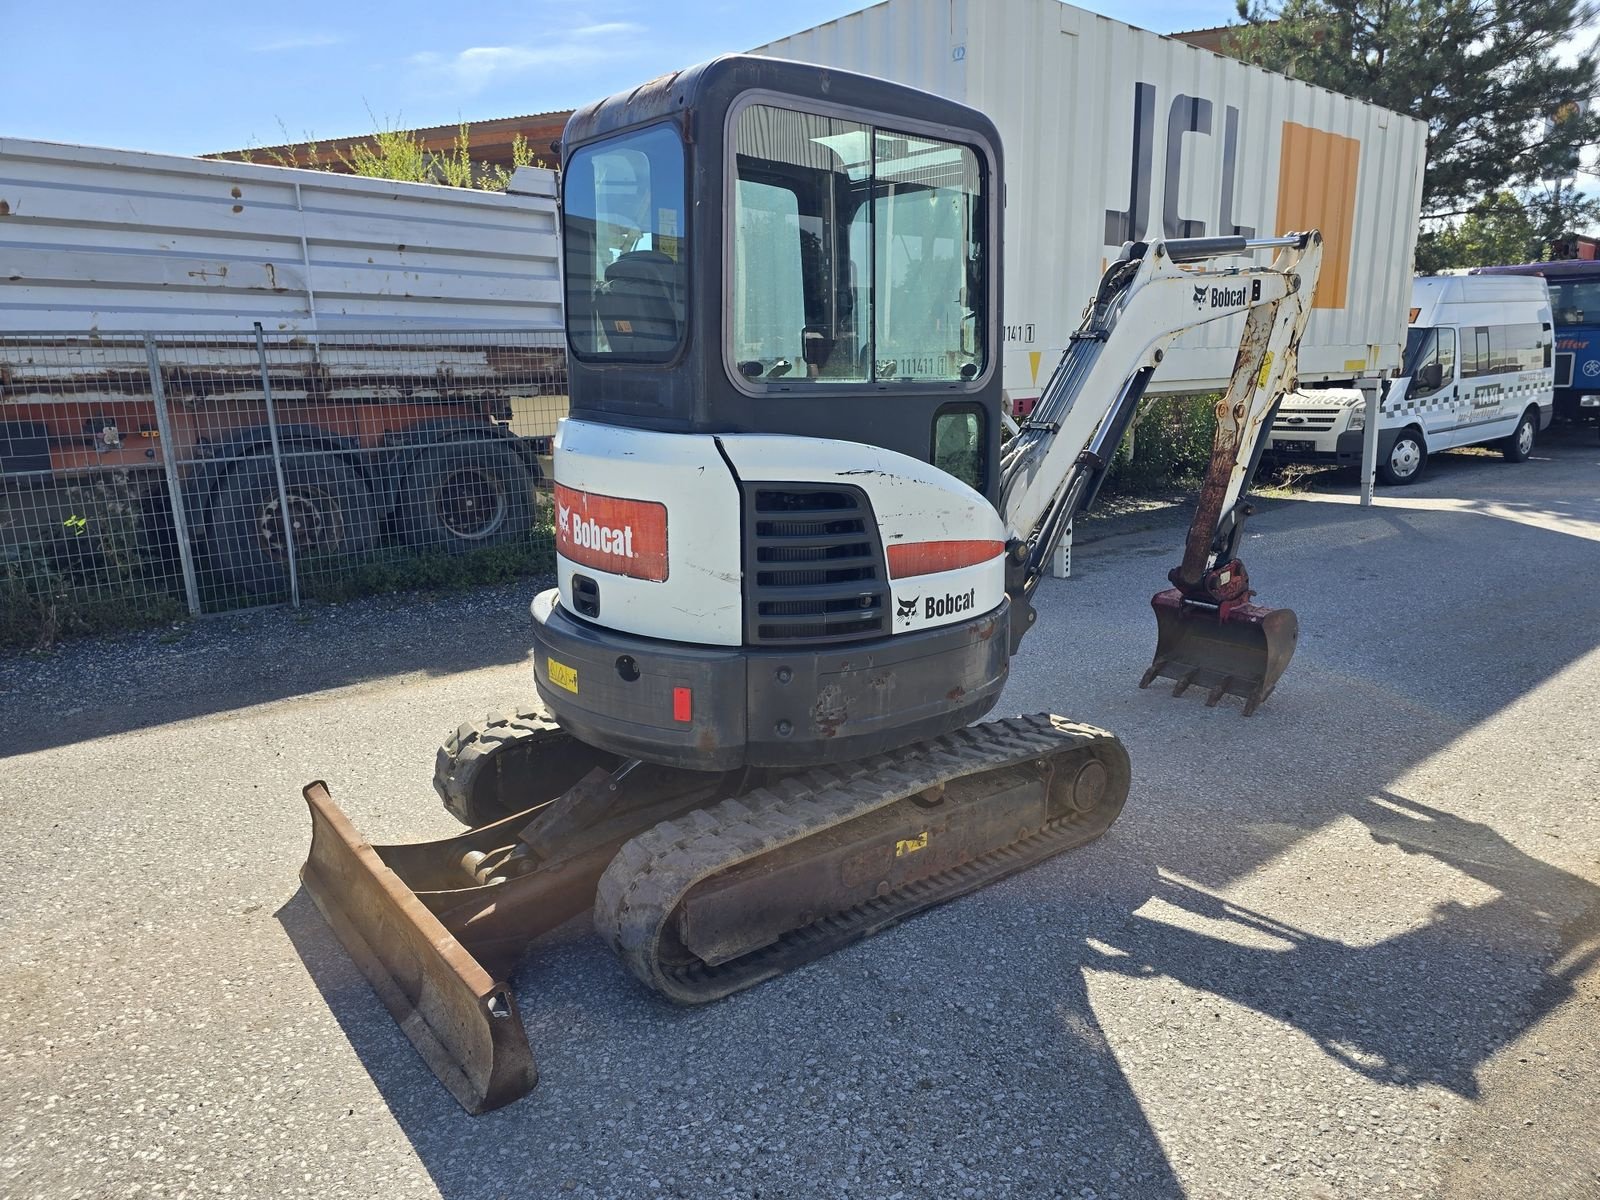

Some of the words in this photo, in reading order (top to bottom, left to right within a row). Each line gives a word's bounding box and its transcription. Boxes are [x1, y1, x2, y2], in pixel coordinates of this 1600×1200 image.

[1104, 81, 1256, 259] JCL
[1211, 287, 1247, 308] Bobcat
[1477, 387, 1498, 406] TAXI
[572, 513, 634, 558] Bobcat
[925, 587, 975, 620] Bobcat
